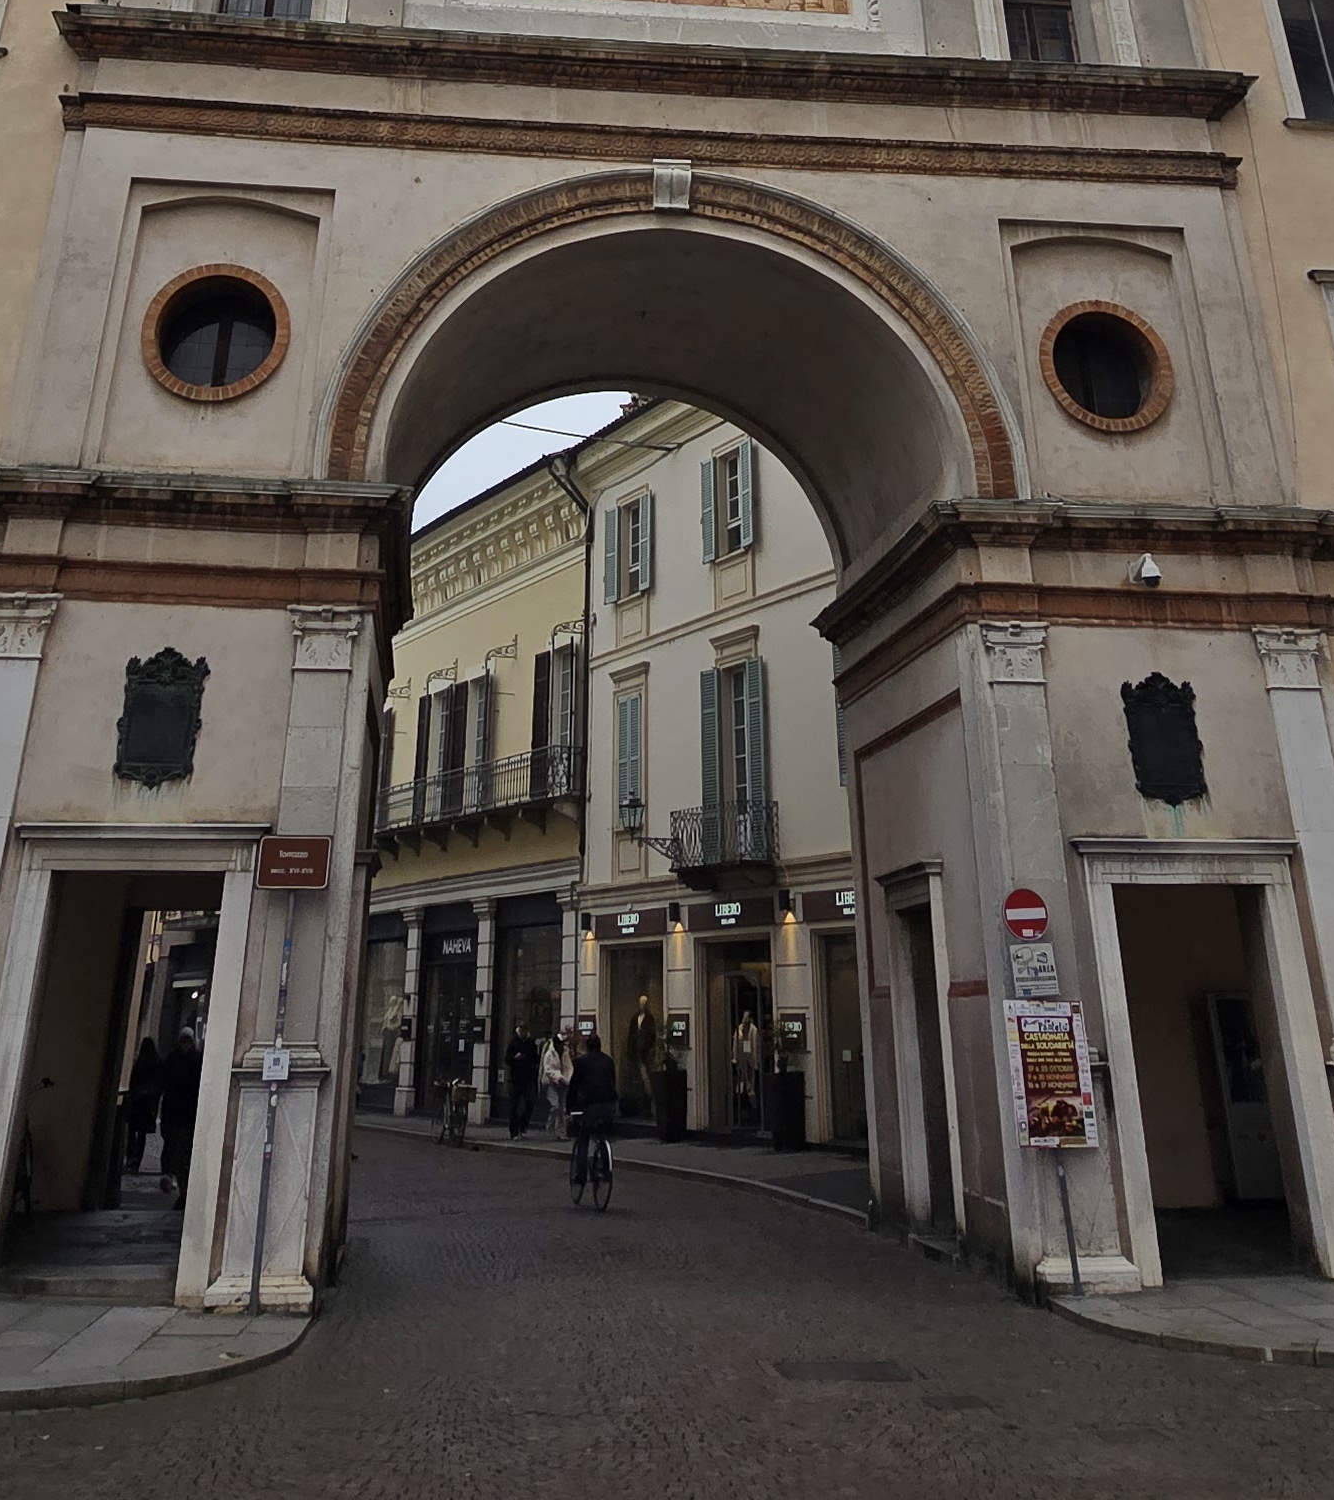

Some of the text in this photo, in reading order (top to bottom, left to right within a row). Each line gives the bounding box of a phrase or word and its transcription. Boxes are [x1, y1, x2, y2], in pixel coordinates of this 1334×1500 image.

[835, 891, 856, 906] LIBE
[715, 902, 741, 917] LIBERO
[617, 912, 639, 926] LIBERO
